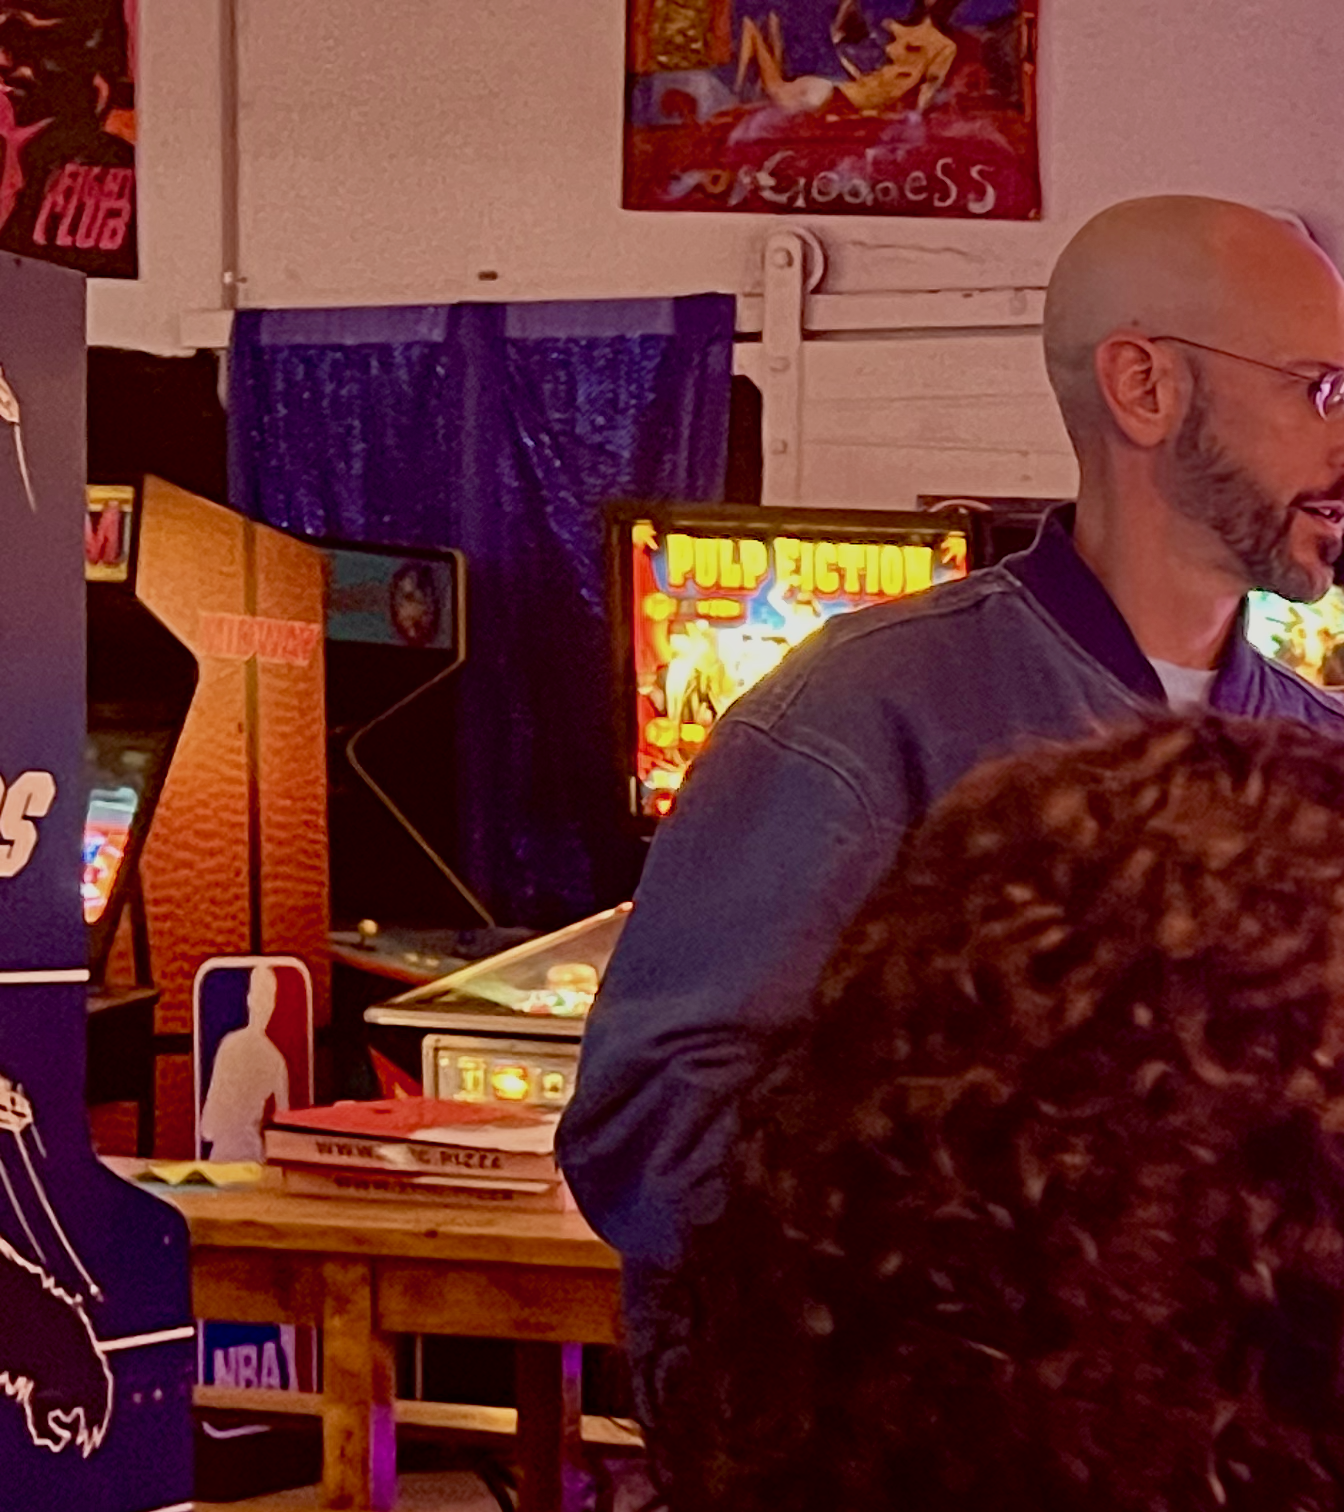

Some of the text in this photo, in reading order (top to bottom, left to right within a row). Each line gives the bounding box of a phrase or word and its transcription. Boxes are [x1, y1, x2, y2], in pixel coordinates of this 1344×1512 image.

[666, 533, 933, 595] PULP FICTION
[0, 770, 56, 878] S
[213, 1341, 281, 1388] NBA
